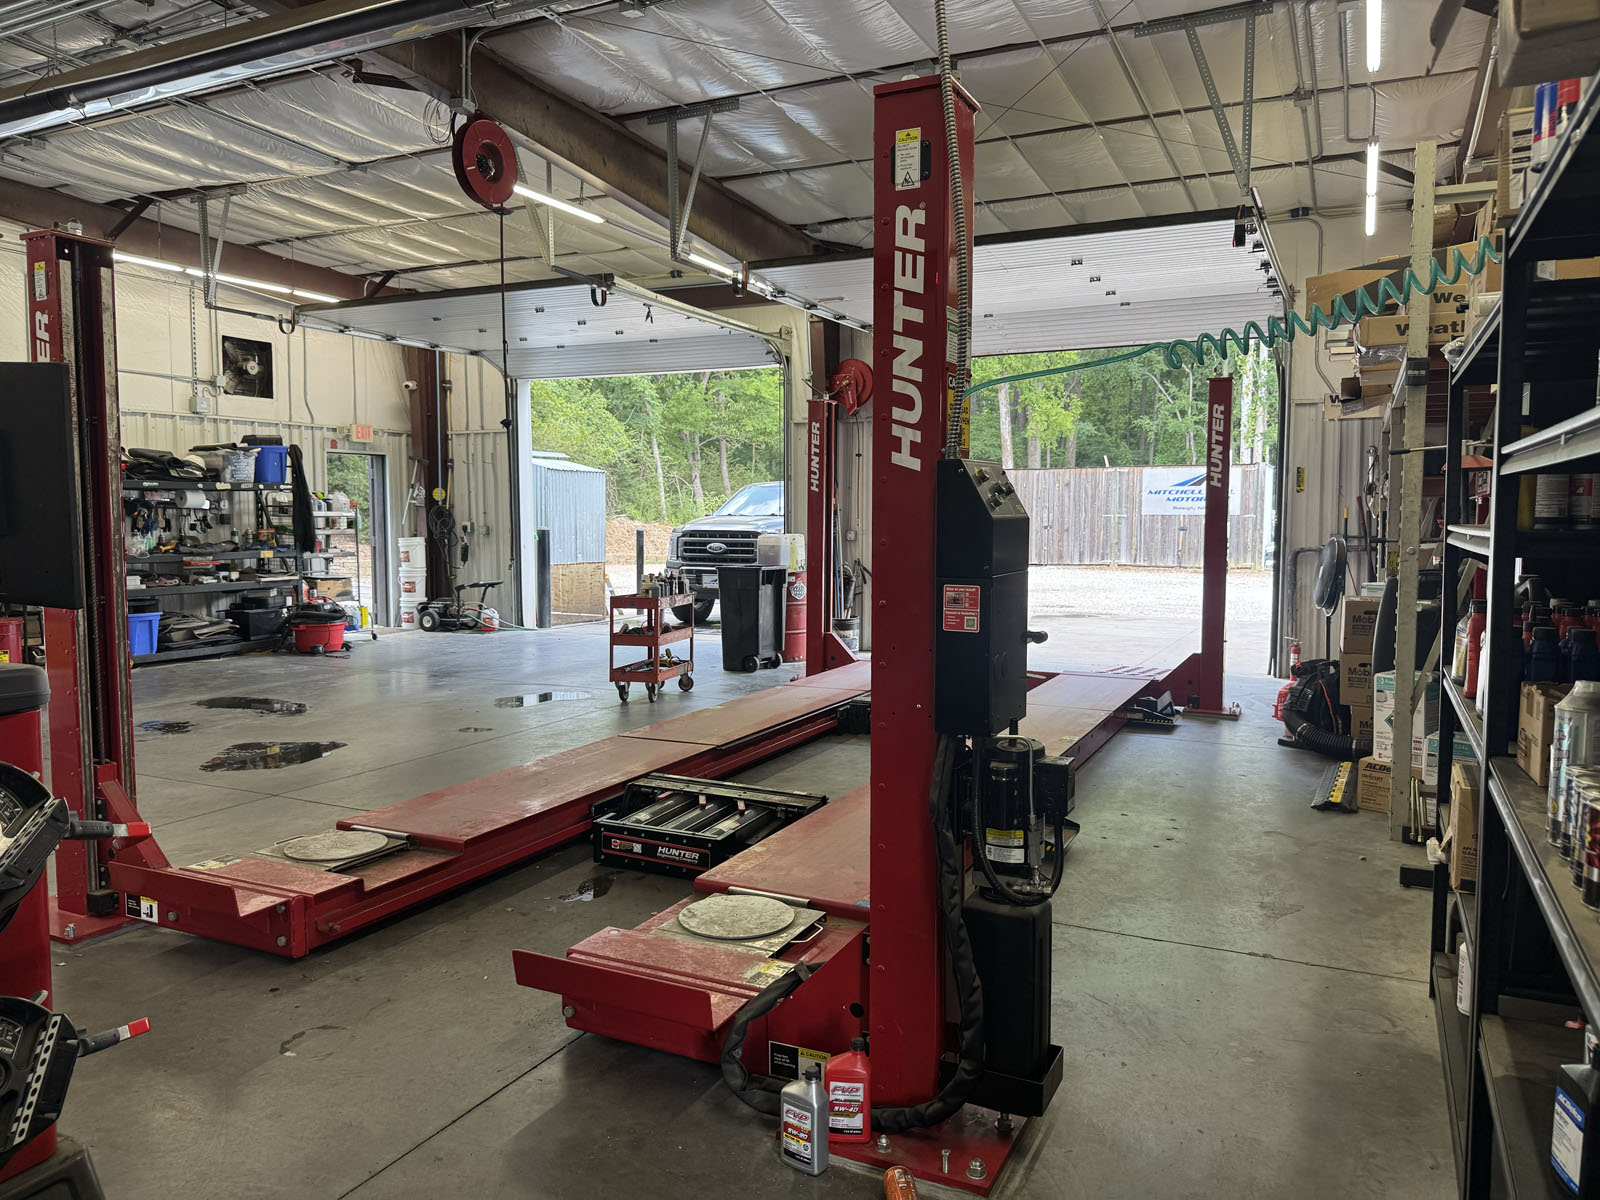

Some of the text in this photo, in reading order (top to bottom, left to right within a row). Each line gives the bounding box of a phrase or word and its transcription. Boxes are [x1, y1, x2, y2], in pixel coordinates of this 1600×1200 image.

[891, 204, 926, 472] HUNTER
[355, 424, 371, 441] EXIT
[1210, 403, 1225, 488] HUNTER
[810, 421, 820, 492] HUNTER
[657, 846, 700, 860] HUNTER
[805, 1051, 828, 1060] CAUTION
